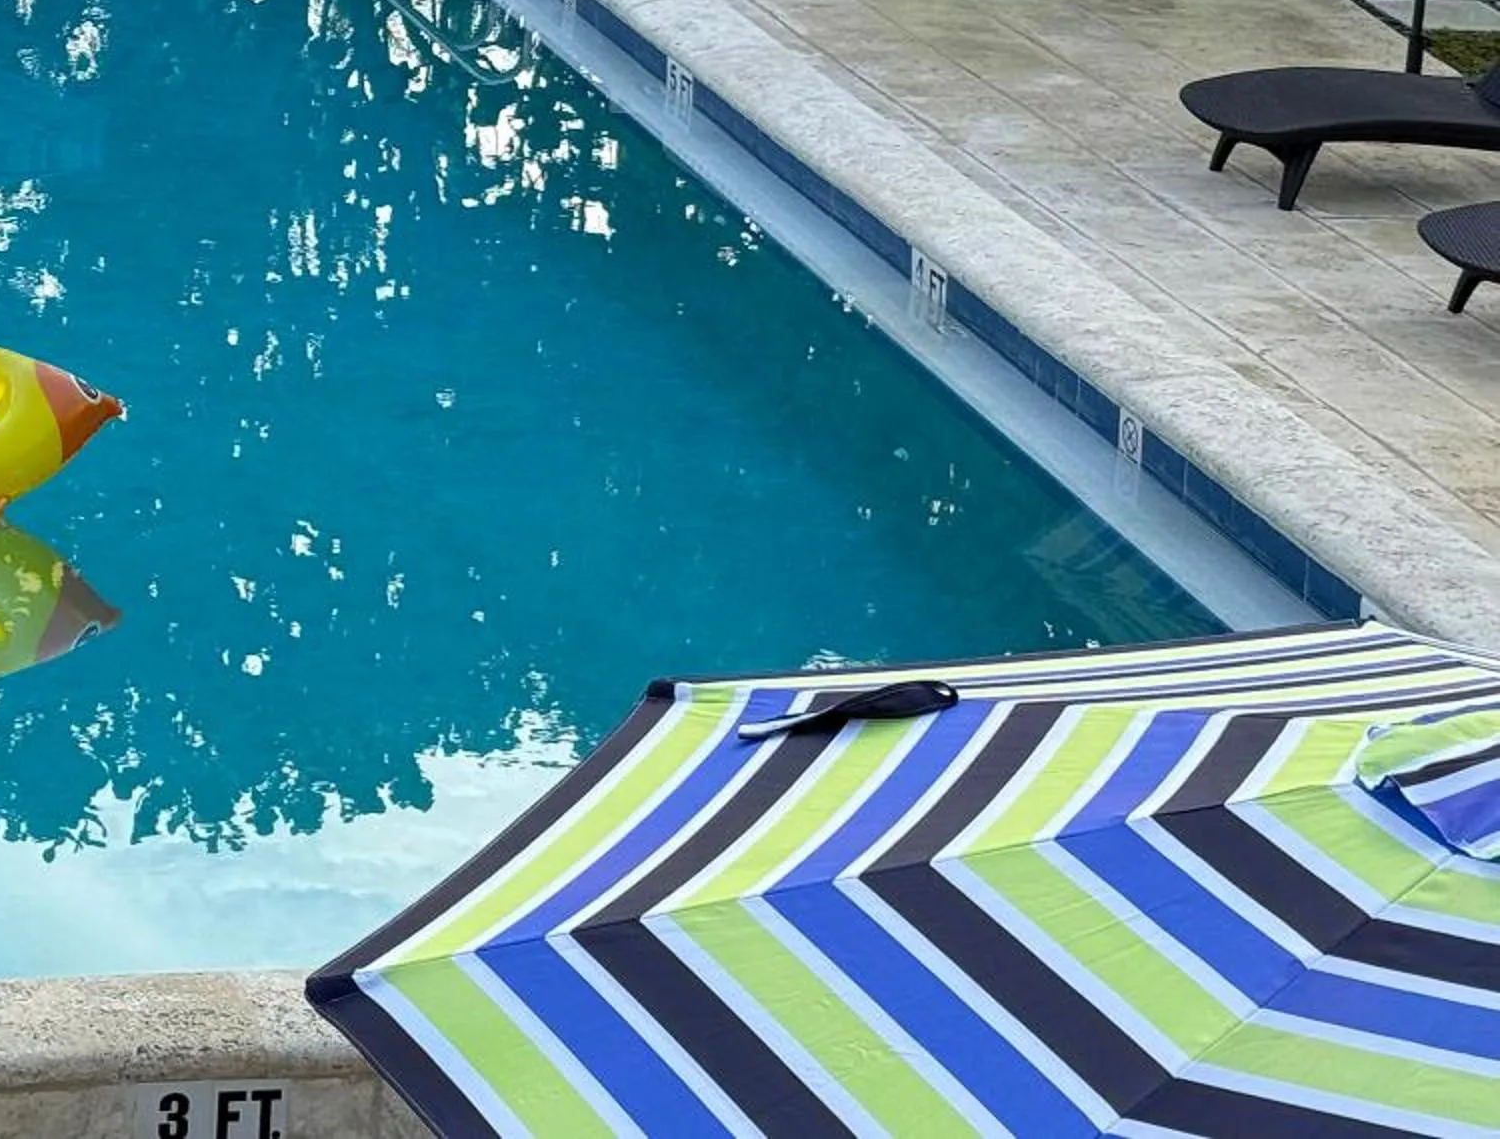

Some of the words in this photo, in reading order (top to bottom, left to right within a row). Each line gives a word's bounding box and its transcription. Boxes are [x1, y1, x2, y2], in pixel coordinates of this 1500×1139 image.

[680, 73, 692, 104] FT
[916, 257, 923, 287] 4
[929, 268, 945, 304] FT
[158, 1092, 190, 1139] 3
